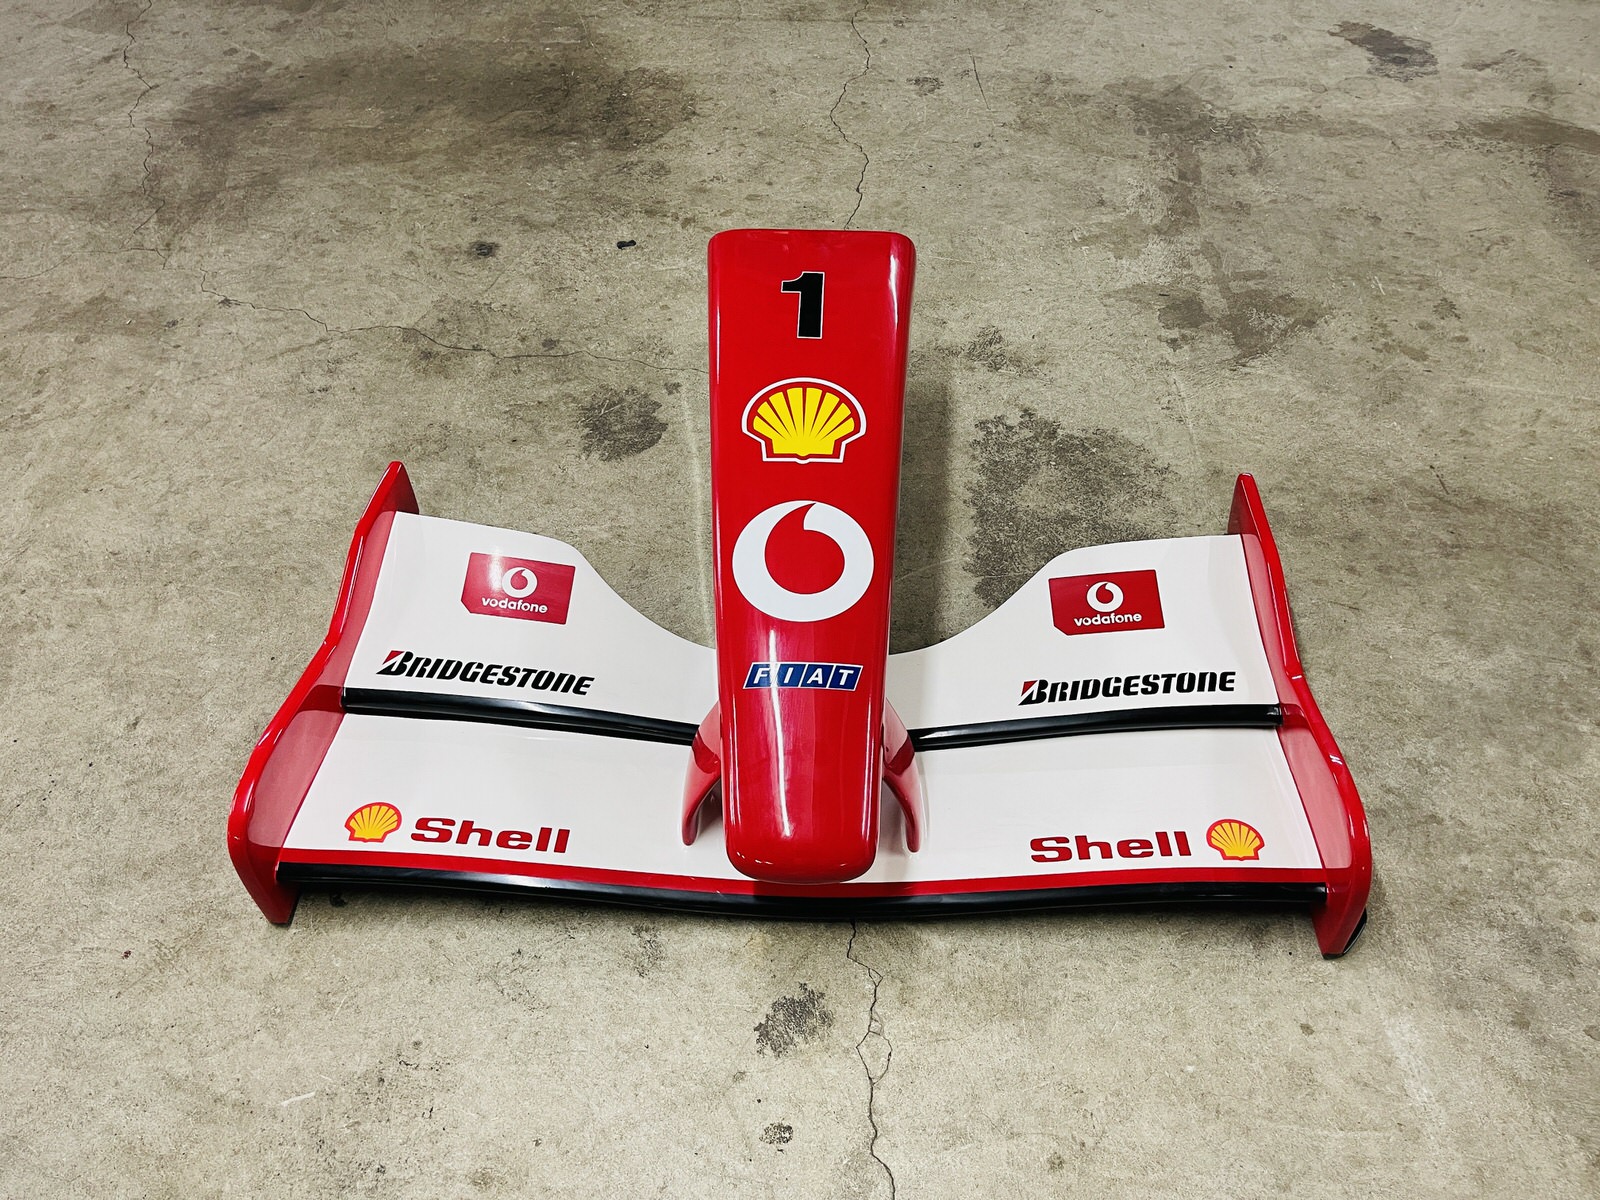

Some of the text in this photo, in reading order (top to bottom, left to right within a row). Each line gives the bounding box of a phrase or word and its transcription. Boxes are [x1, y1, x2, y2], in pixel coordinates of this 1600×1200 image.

[780, 271, 825, 339] 1
[481, 597, 548, 614] vodafone
[1073, 611, 1143, 627] vodafone
[376, 650, 595, 695] BRIDGESTONE
[752, 666, 856, 687] FIAT
[1018, 671, 1236, 706] BRIDGESTONE
[411, 817, 571, 853] Shell
[1029, 831, 1192, 863] Shell
